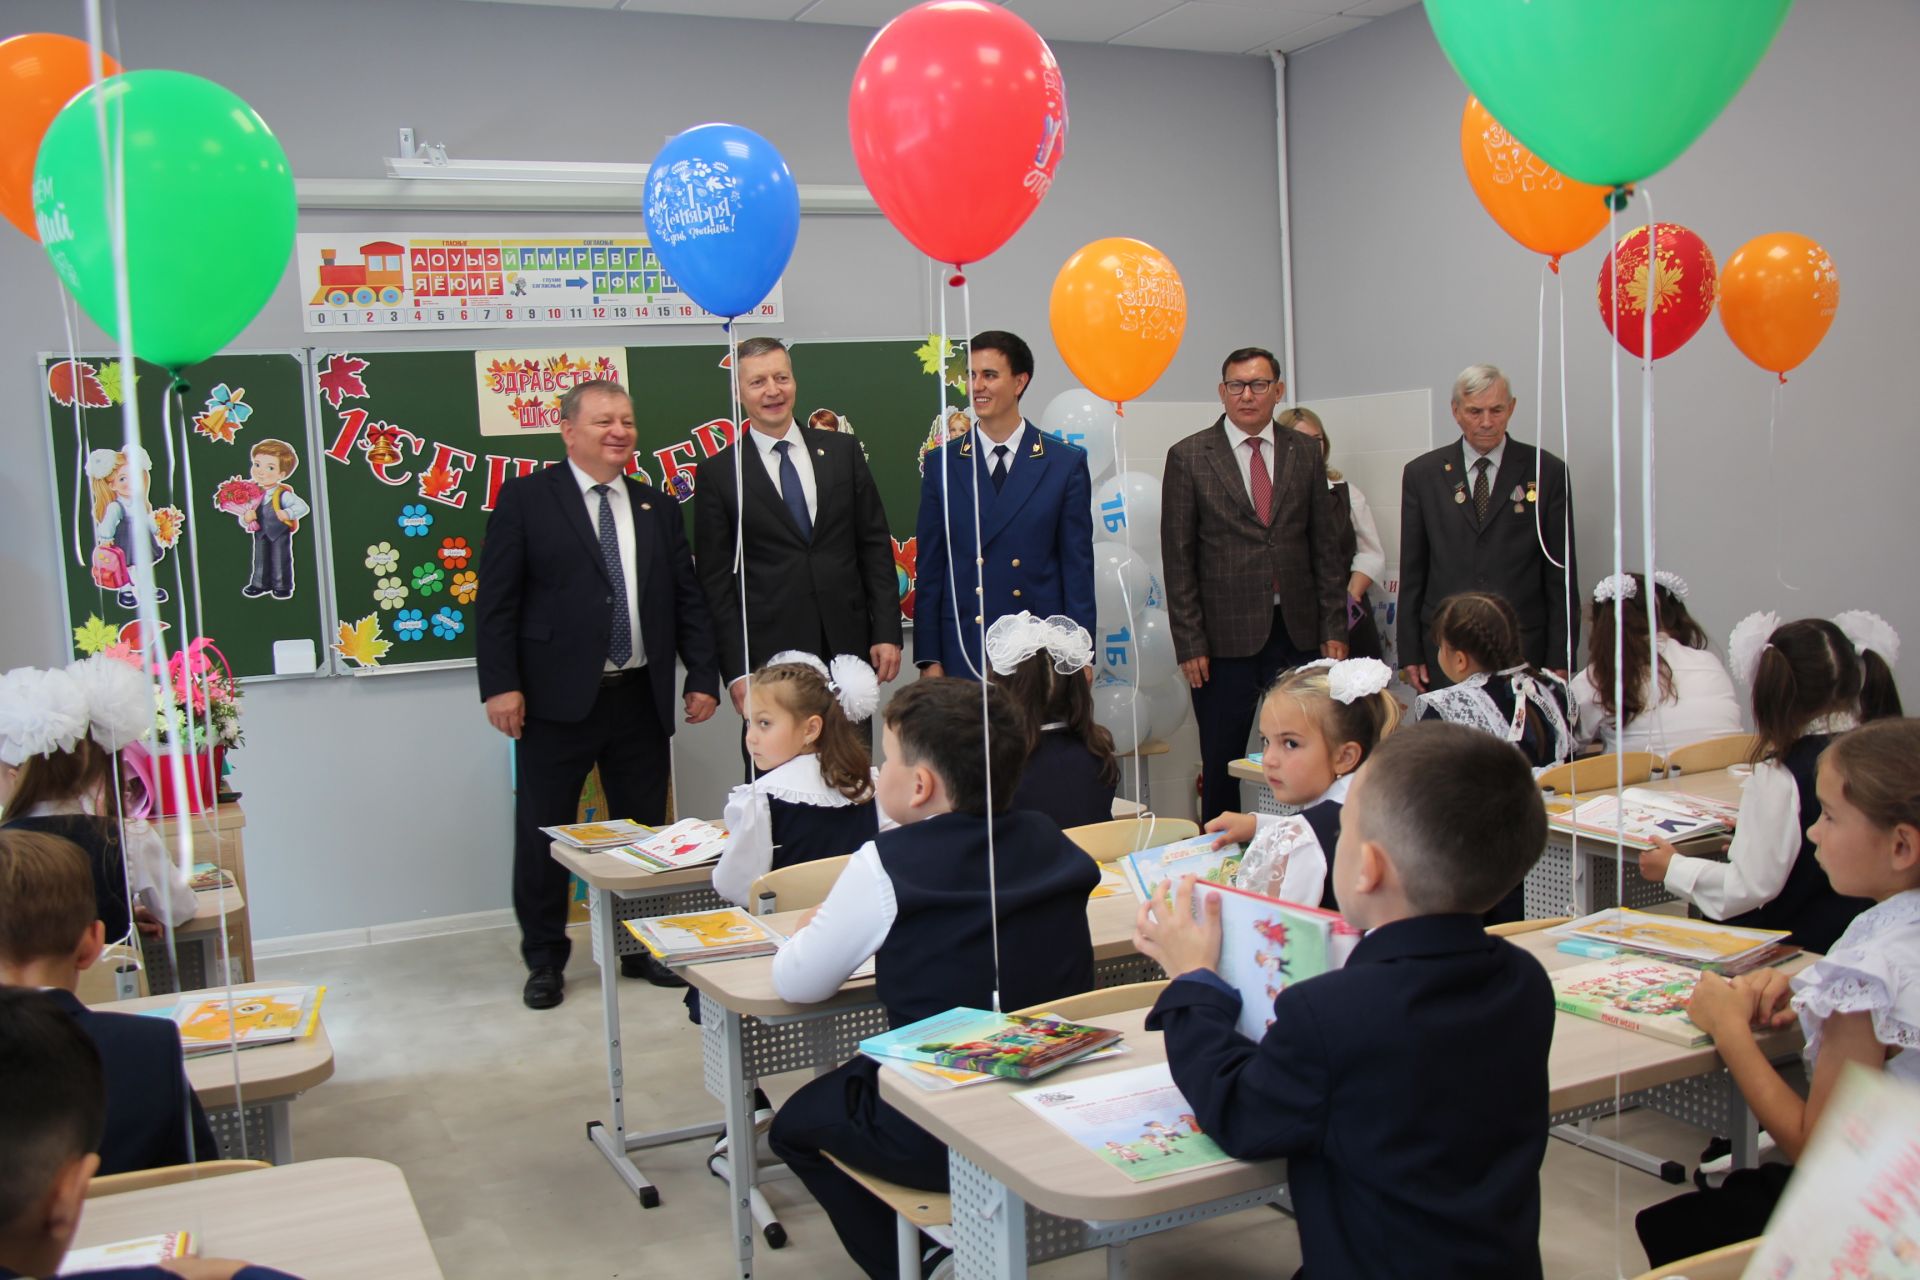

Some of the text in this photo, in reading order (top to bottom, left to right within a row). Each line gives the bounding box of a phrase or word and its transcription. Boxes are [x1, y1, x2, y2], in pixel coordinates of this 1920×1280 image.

[414, 250, 658, 266] А О У Ы Э Й Л М Н Р Б В Г Д
[416, 275, 500, 290] Я Ё Ю И Е
[595, 276, 606, 288] П
[611, 275, 624, 289] Ф
[630, 276, 640, 288] К
[647, 276, 657, 288] Т
[318, 313, 325, 323] 0
[342, 312, 348, 322] 1
[366, 312, 374, 322] 2
[390, 311, 398, 321] 3
[414, 310, 422, 320] 4
[437, 310, 445, 320] 5
[460, 310, 468, 320] 6
[484, 310, 491, 320] 7
[505, 309, 513, 319] 8
[529, 309, 536, 319] 9
[548, 308, 561, 319] 10
[571, 308, 583, 318] 11
[592, 308, 605, 318] 12
[615, 307, 627, 317] 13
[635, 307, 648, 317] 14
[657, 306, 670, 316] 15
[679, 306, 692, 316] 16
[761, 305, 774, 315] 20
[518, 405, 562, 429] ШКО
[1105, 625, 1131, 667] 1Б
